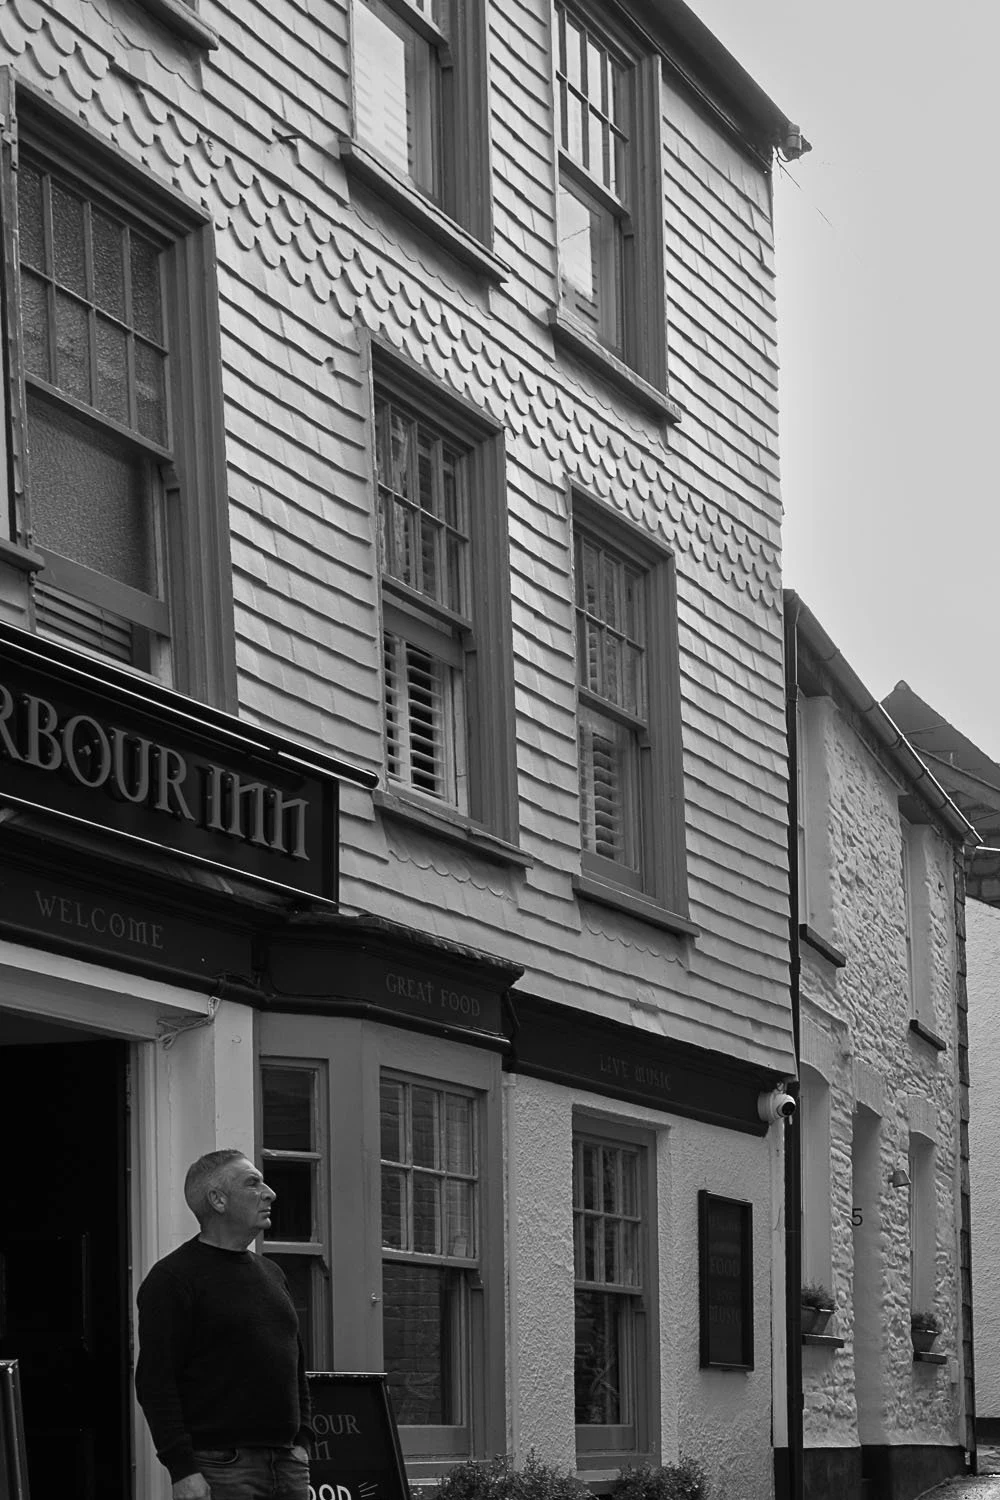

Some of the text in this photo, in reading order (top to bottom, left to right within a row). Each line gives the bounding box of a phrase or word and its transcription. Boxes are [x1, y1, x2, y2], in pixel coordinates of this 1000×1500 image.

[34, 890, 164, 949] WELCOME
[385, 972, 481, 1016] GREAT FOOD
[600, 1054, 672, 1092] LIVE MUSIC
[852, 1207, 863, 1227] 5
